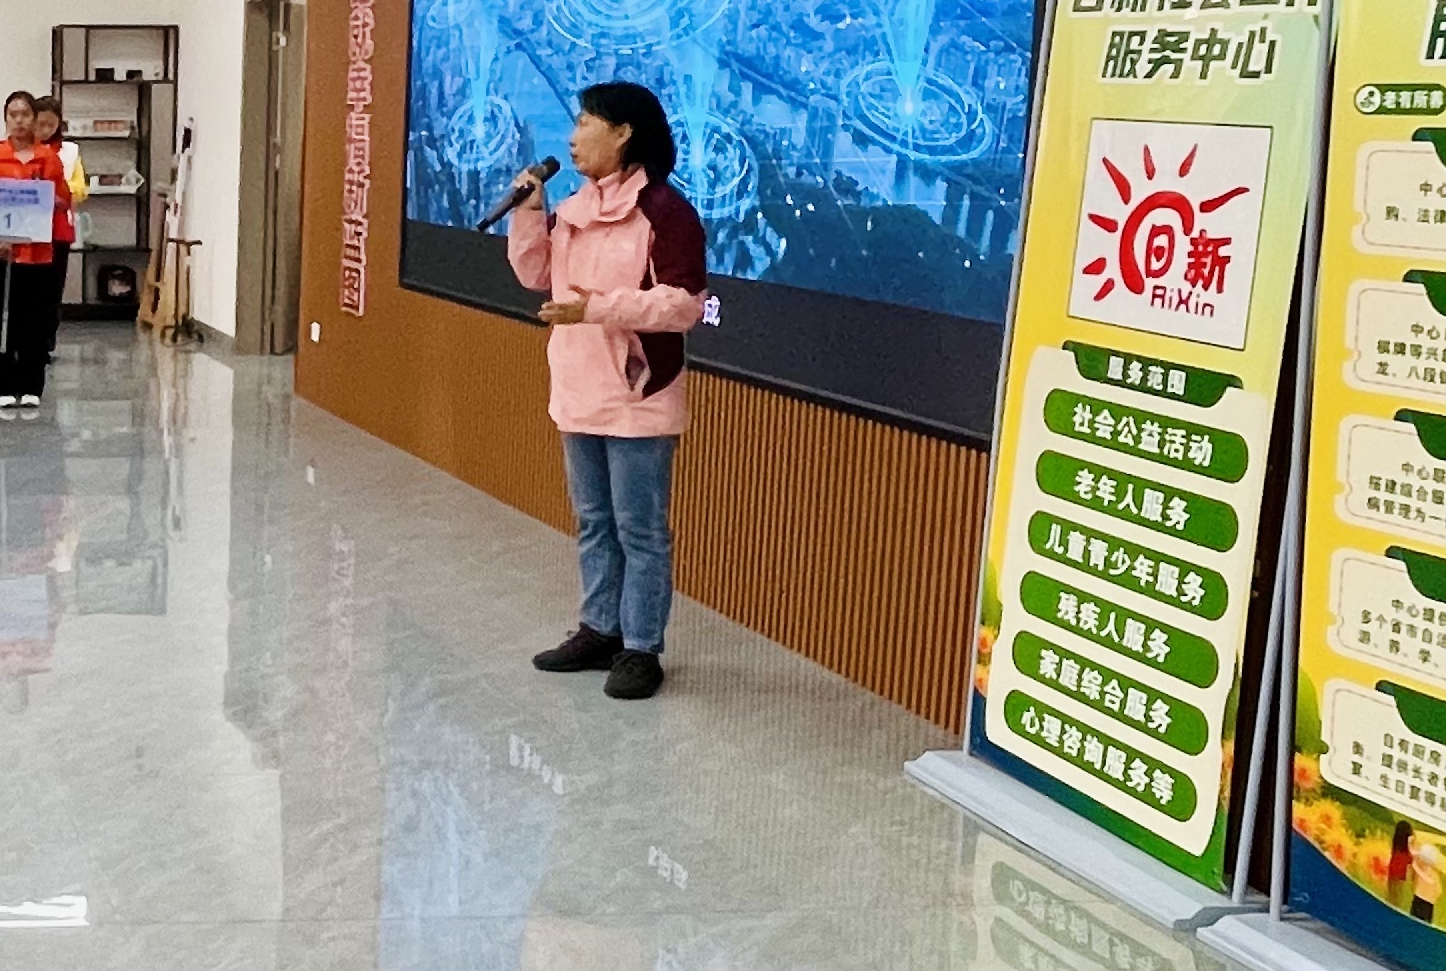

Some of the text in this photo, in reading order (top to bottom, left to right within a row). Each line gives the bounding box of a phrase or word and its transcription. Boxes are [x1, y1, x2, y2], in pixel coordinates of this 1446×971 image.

[1102, 26, 1276, 79] 服务中心
[4, 213, 12, 229] 1
[1146, 223, 1232, 295] 日新
[1106, 355, 1187, 396] 服务范围
[1072, 402, 1214, 467] 社会公益活动
[1074, 468, 1190, 531] 老年人服务
[1045, 523, 1205, 607] 儿童青少年服务
[1057, 591, 1171, 663] 残疾人服务
[1039, 649, 1171, 734] 家庭综合服务
[1021, 706, 1175, 806] 心理咨询服务等
